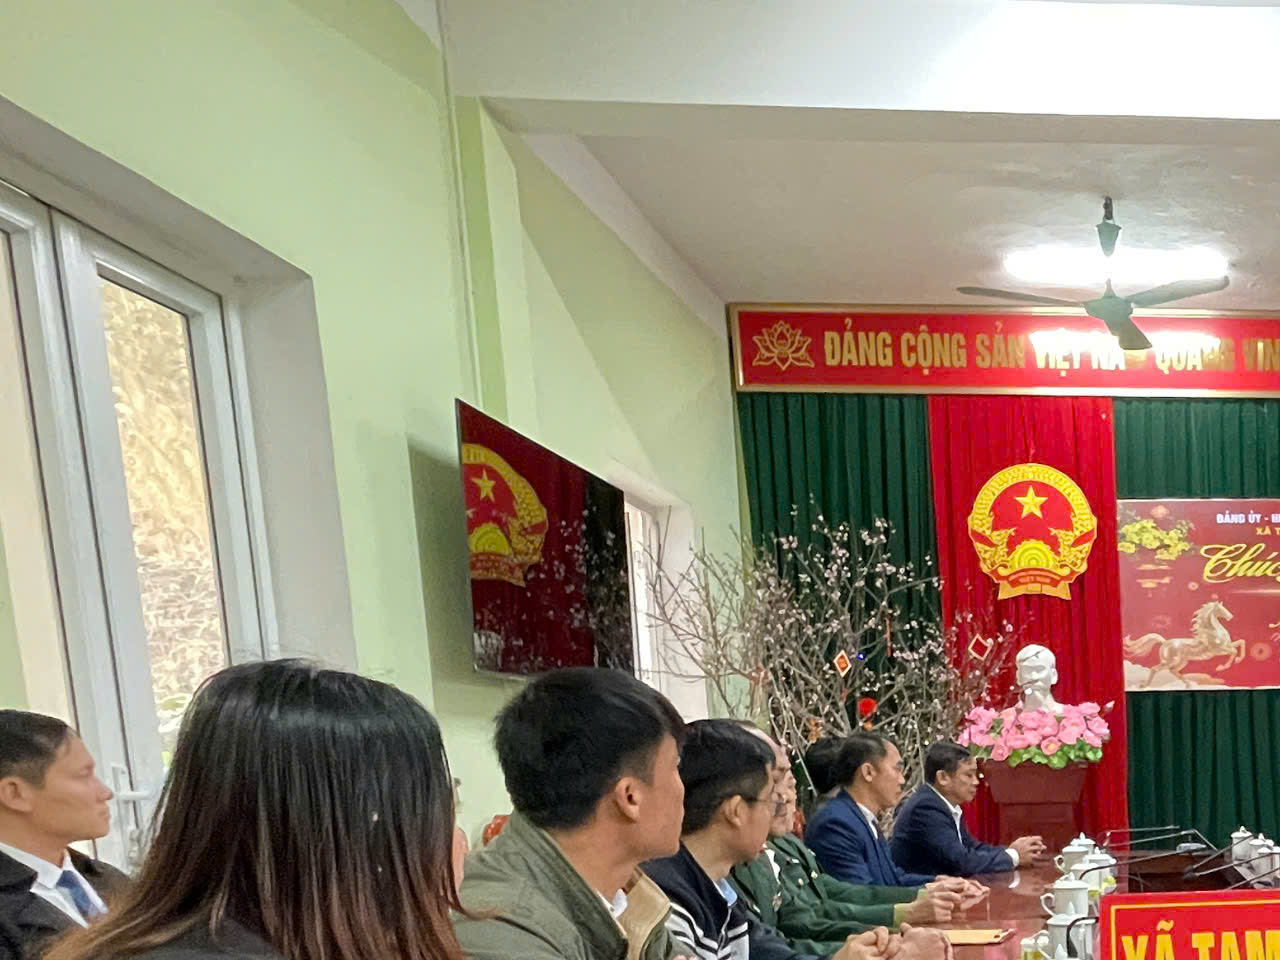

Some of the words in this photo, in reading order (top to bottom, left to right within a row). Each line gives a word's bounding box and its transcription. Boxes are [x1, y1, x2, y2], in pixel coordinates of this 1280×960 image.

[824, 317, 893, 367] ĐẢNG
[900, 324, 967, 375] CỘNG
[975, 320, 1025, 368] SẢN
[1256, 525, 1272, 536] XÃ
